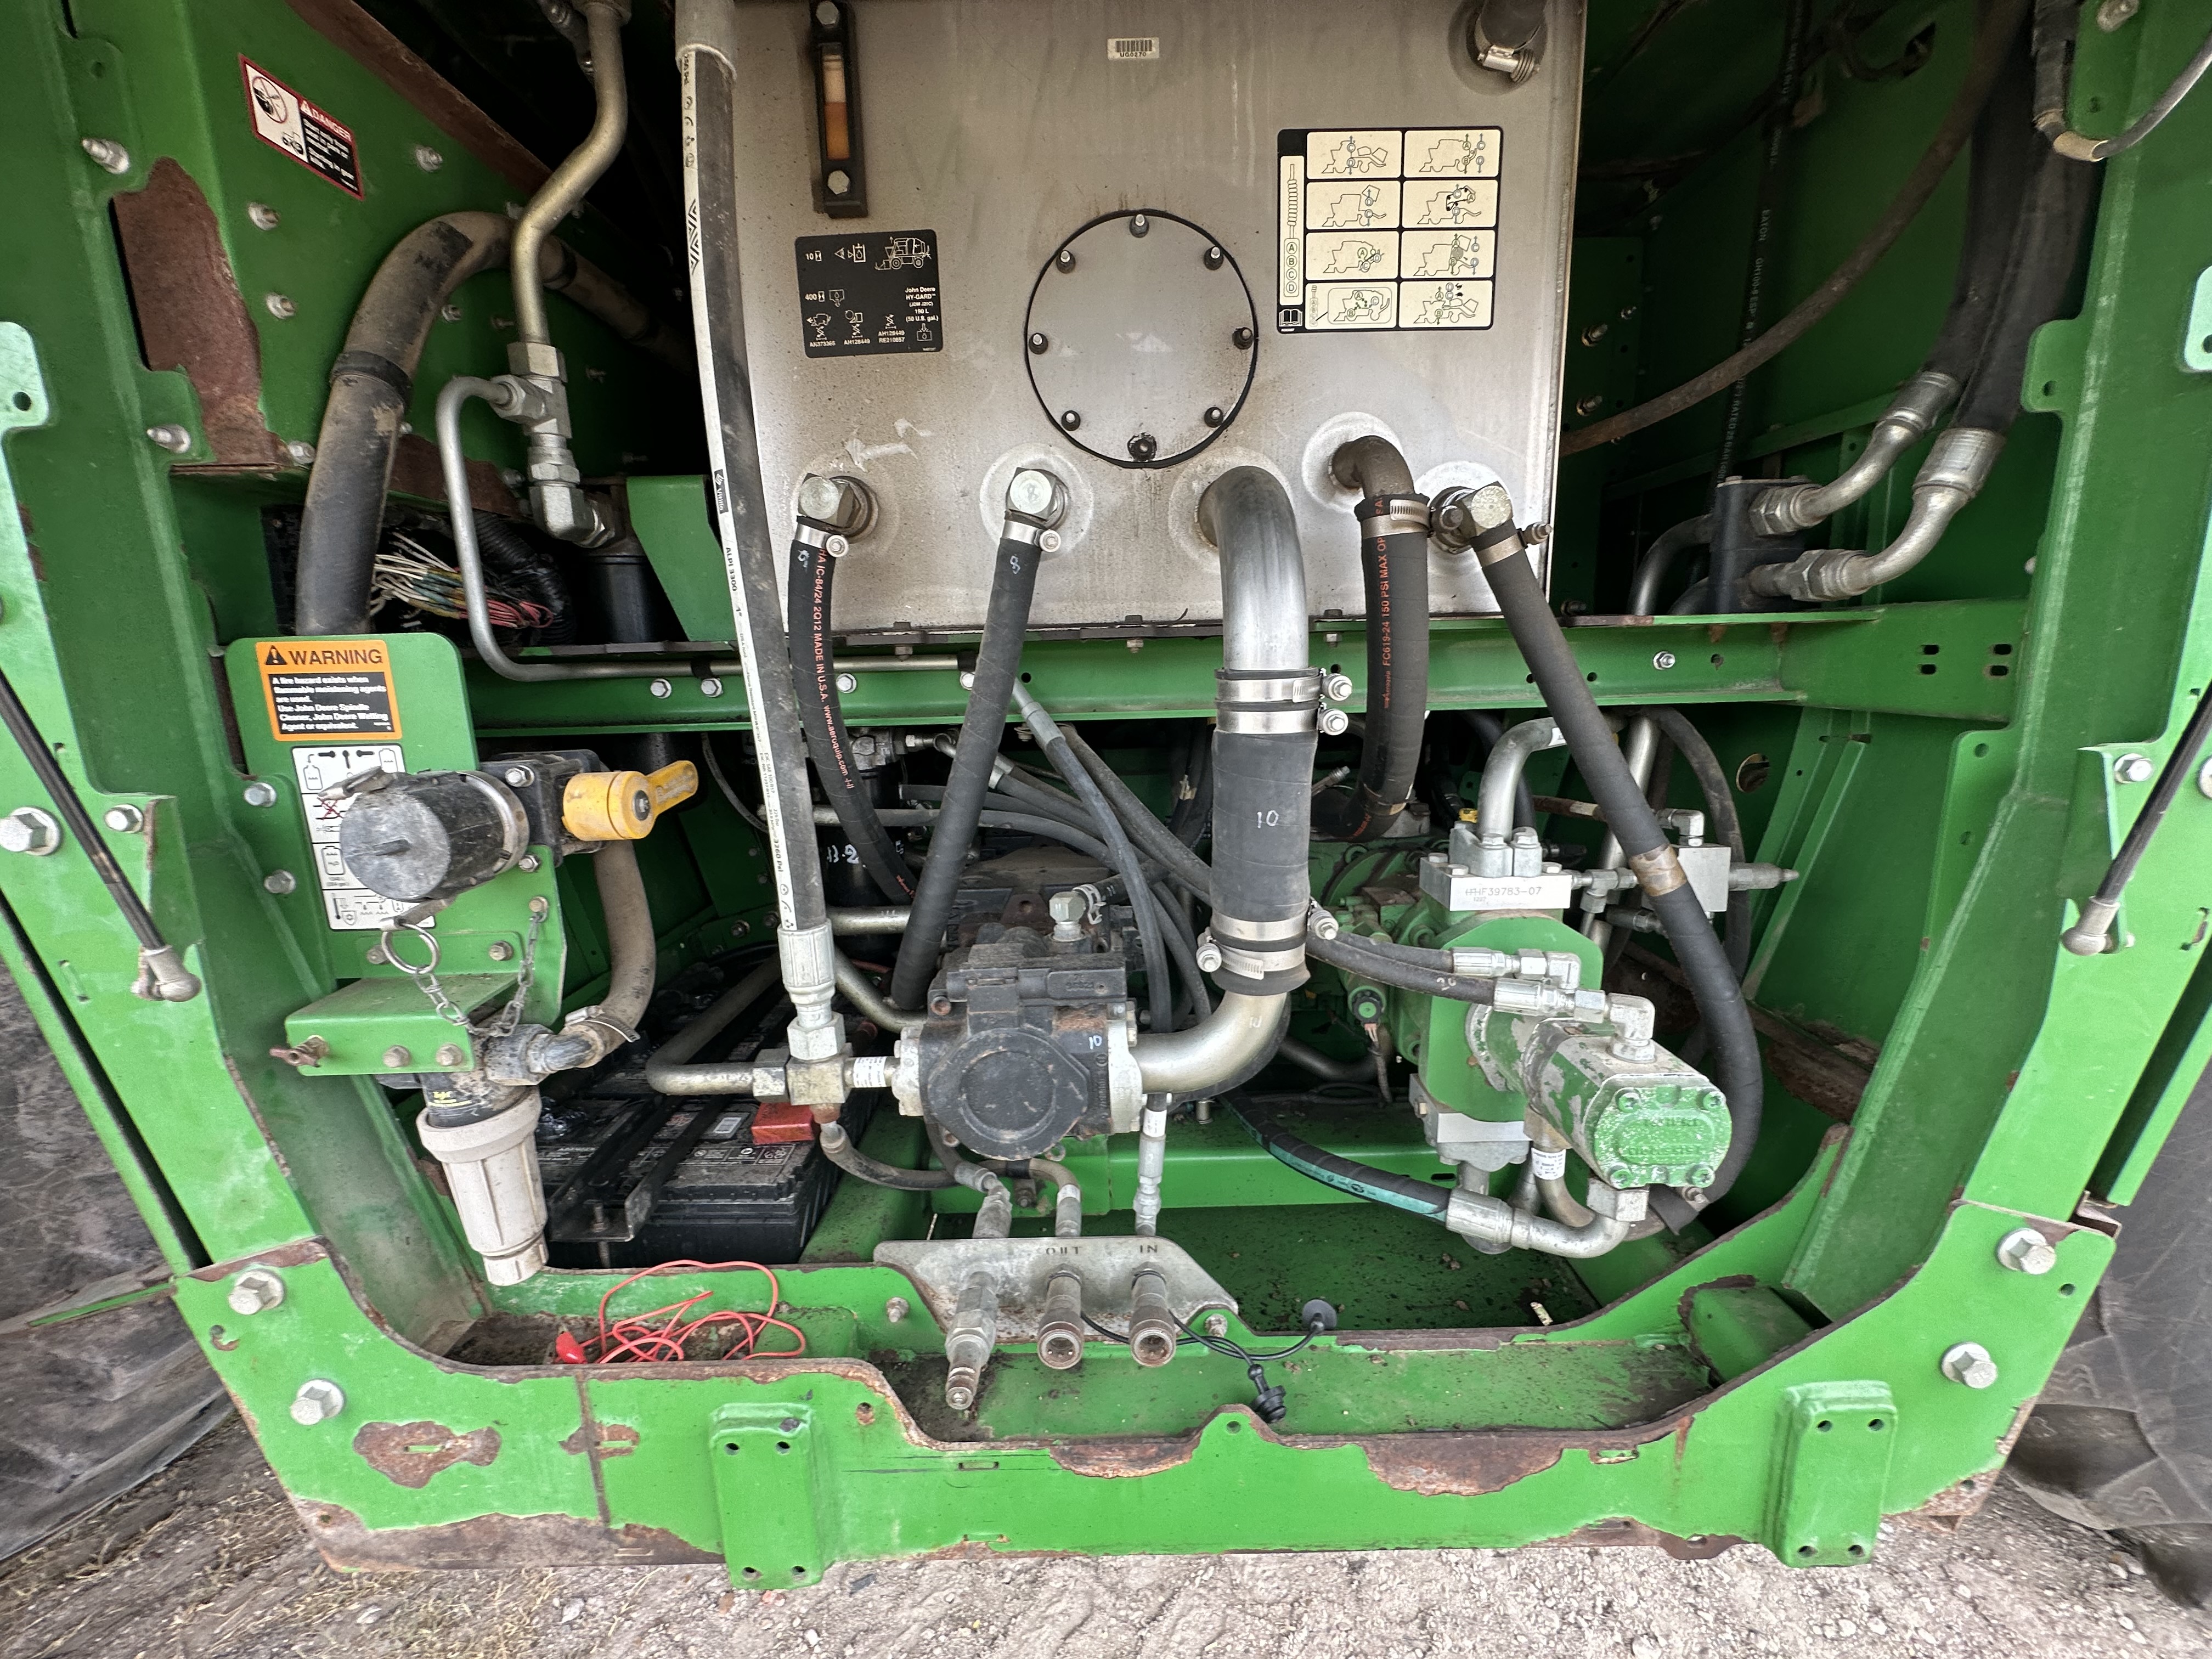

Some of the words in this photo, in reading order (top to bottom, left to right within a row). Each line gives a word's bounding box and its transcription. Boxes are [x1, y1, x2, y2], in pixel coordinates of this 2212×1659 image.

[1378, 554, 1389, 578] MAX
[1379, 580, 1390, 598] PSI
[1380, 601, 1390, 617] 150
[814, 633, 824, 662] MADE
[1381, 621, 1391, 667] FC619-24
[289, 649, 383, 665] WARNING
[816, 664, 825, 678] IN
[281, 723, 306, 732] Agent
[1257, 810, 1279, 829] 10
[1088, 1035, 1103, 1050] 10
[1139, 1244, 1158, 1254] IN
